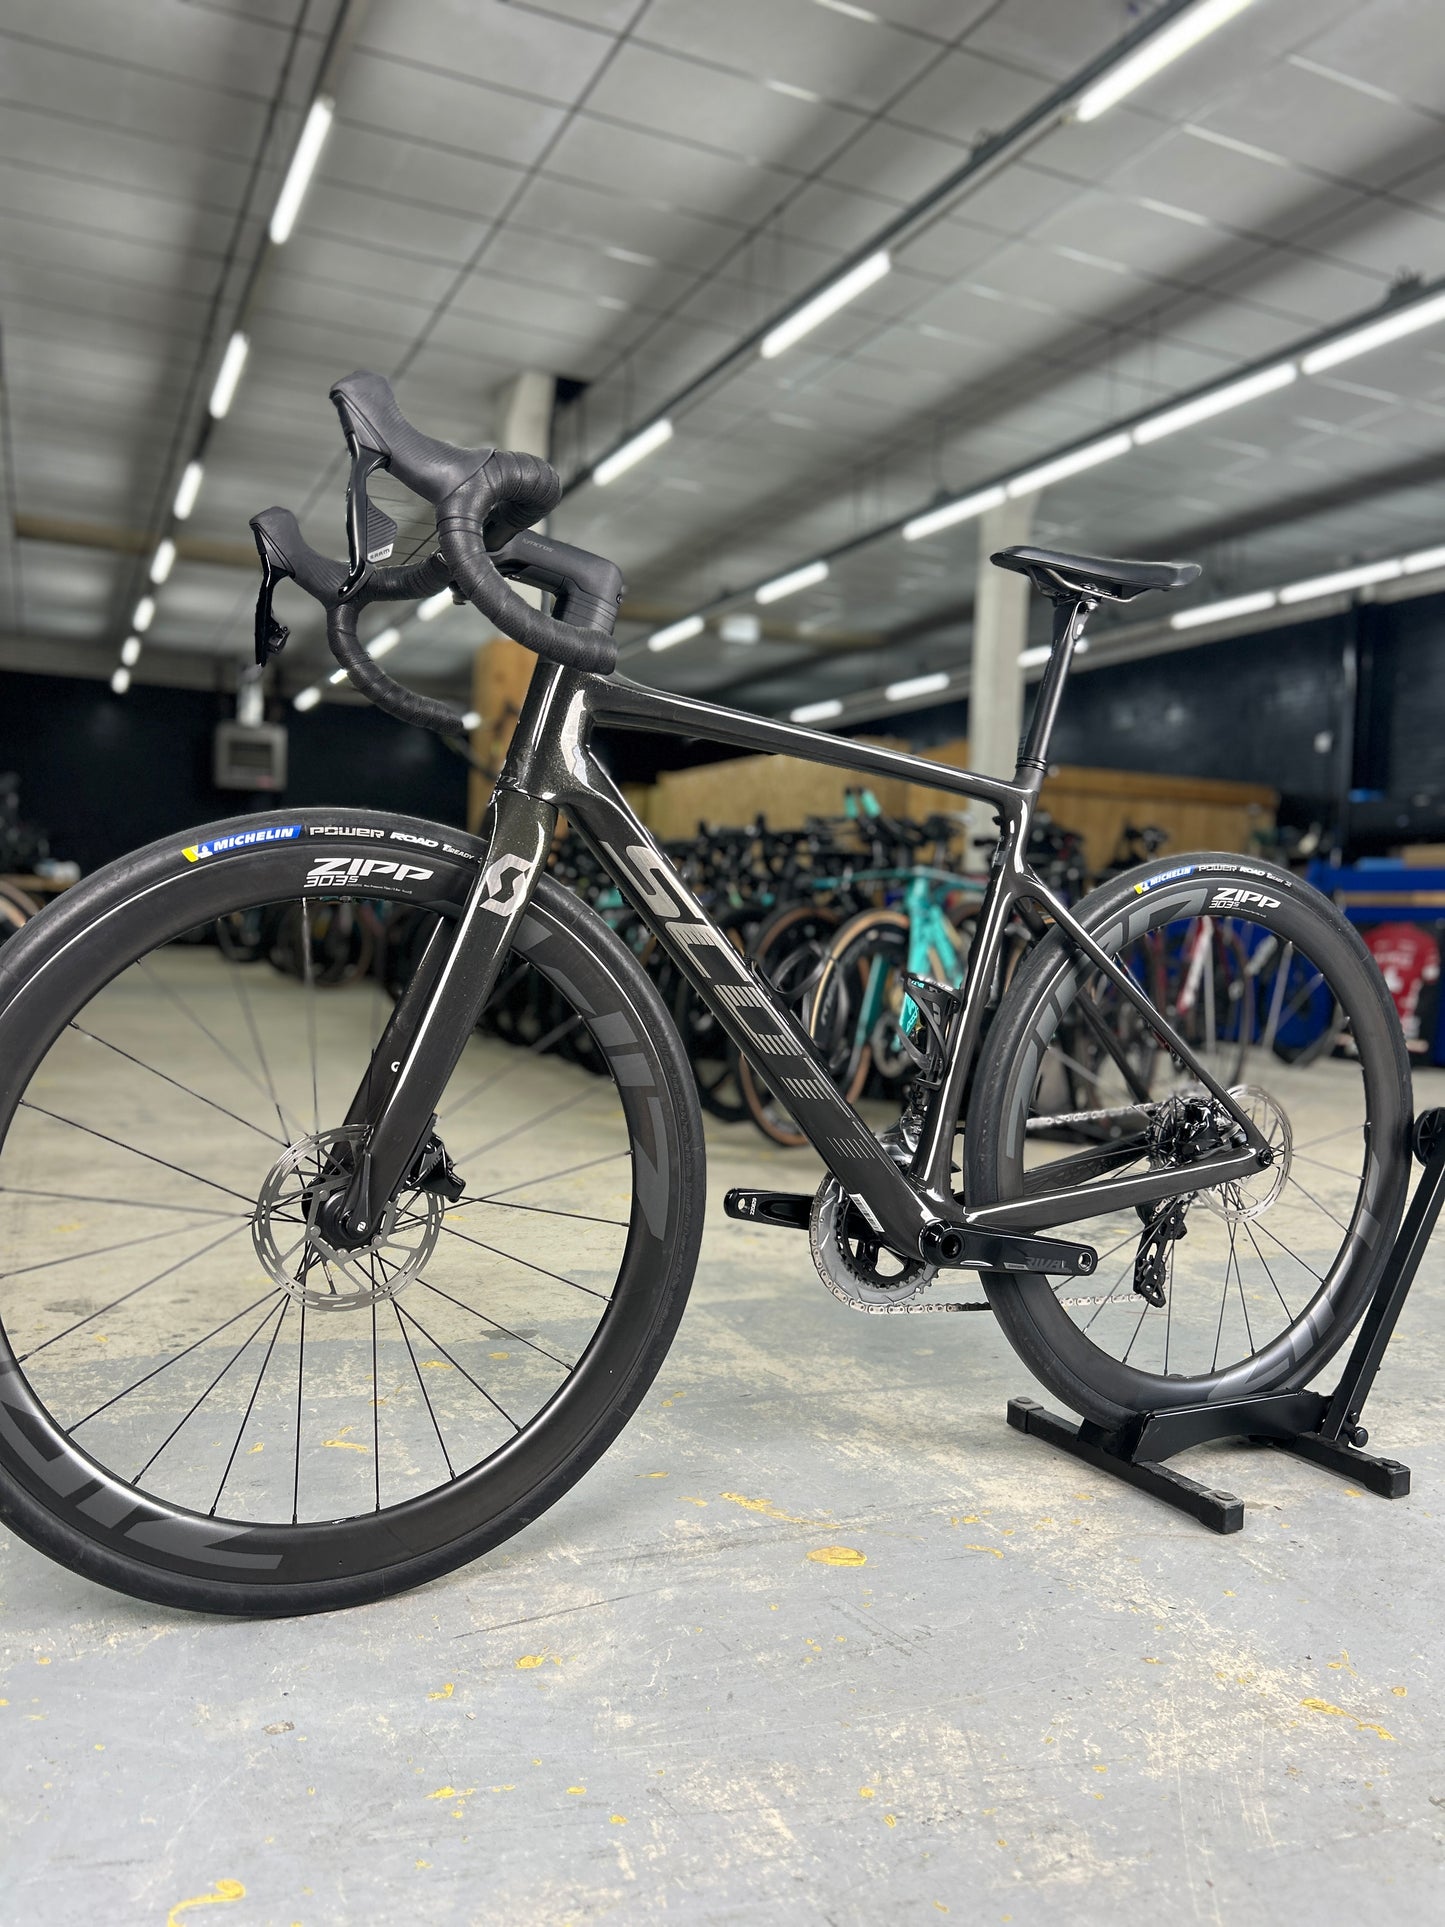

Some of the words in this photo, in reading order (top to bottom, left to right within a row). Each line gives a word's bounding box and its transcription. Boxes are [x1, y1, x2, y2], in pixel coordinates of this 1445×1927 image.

[213, 827, 294, 851] MICHELIN
[309, 826, 385, 839] POWER
[390, 831, 439, 848] ROAD
[307, 857, 434, 881] ZIPP
[1149, 866, 1192, 886] MICHELIN
[1198, 864, 1237, 872] POWER
[1239, 866, 1266, 877] ROAD
[1211, 887, 1281, 909] ZIPP
